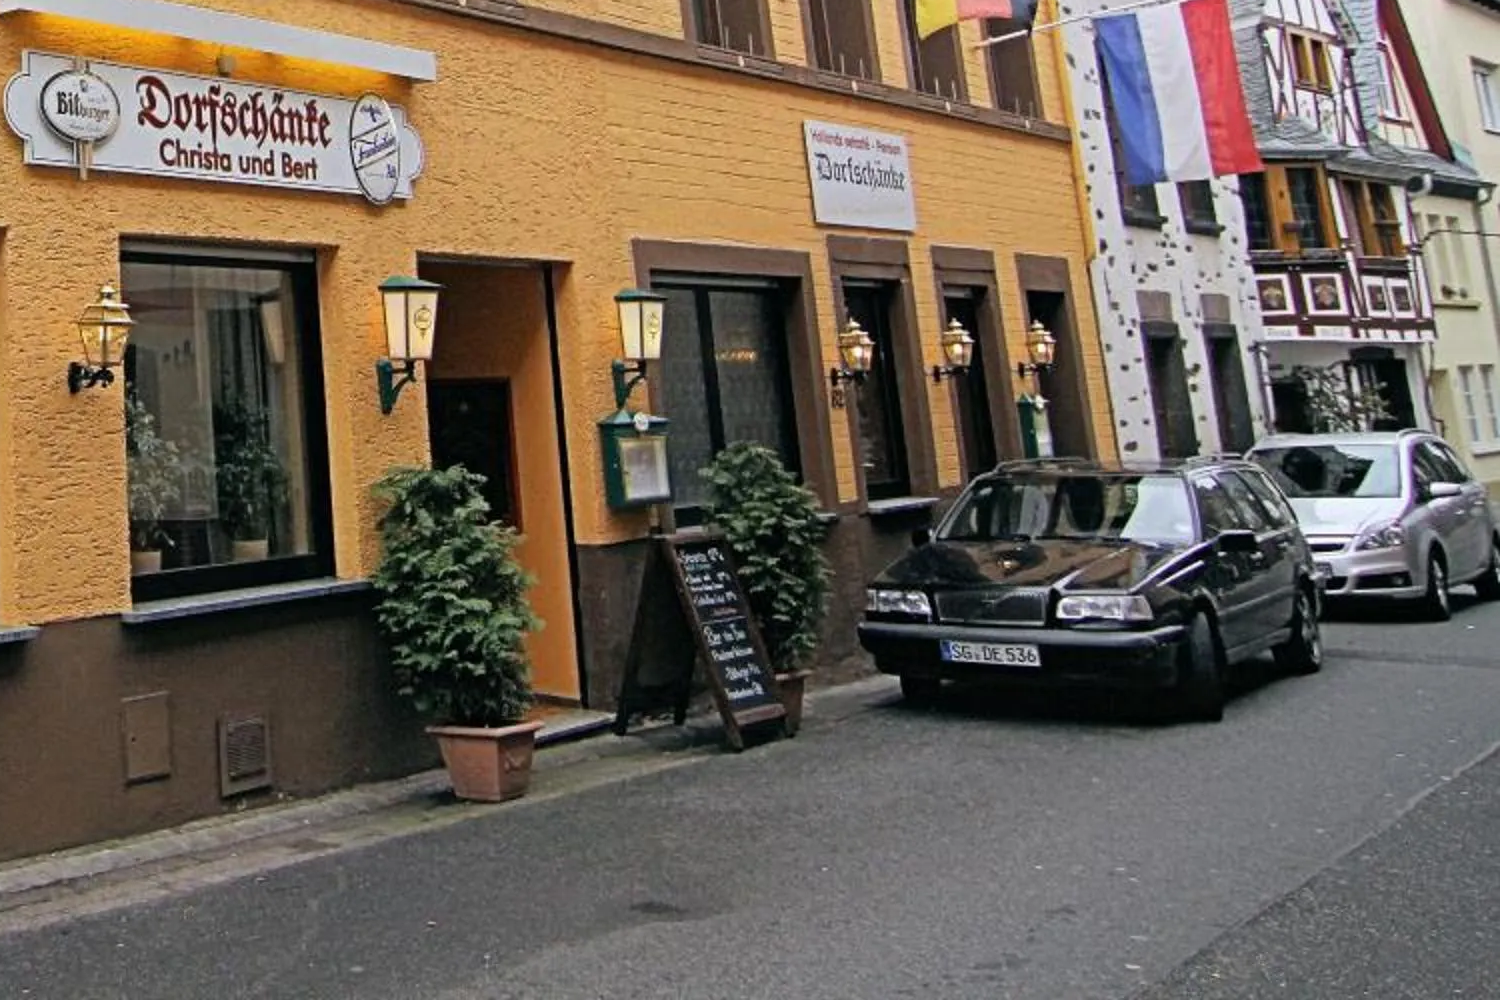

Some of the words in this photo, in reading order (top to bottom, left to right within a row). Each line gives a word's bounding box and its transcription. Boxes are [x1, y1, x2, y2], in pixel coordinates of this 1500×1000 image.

[135, 75, 332, 149] Dorfschänke
[159, 137, 232, 172] Christa
[239, 150, 275, 176] und
[281, 151, 318, 180] Bert
[1005, 647, 1037, 663] 536
